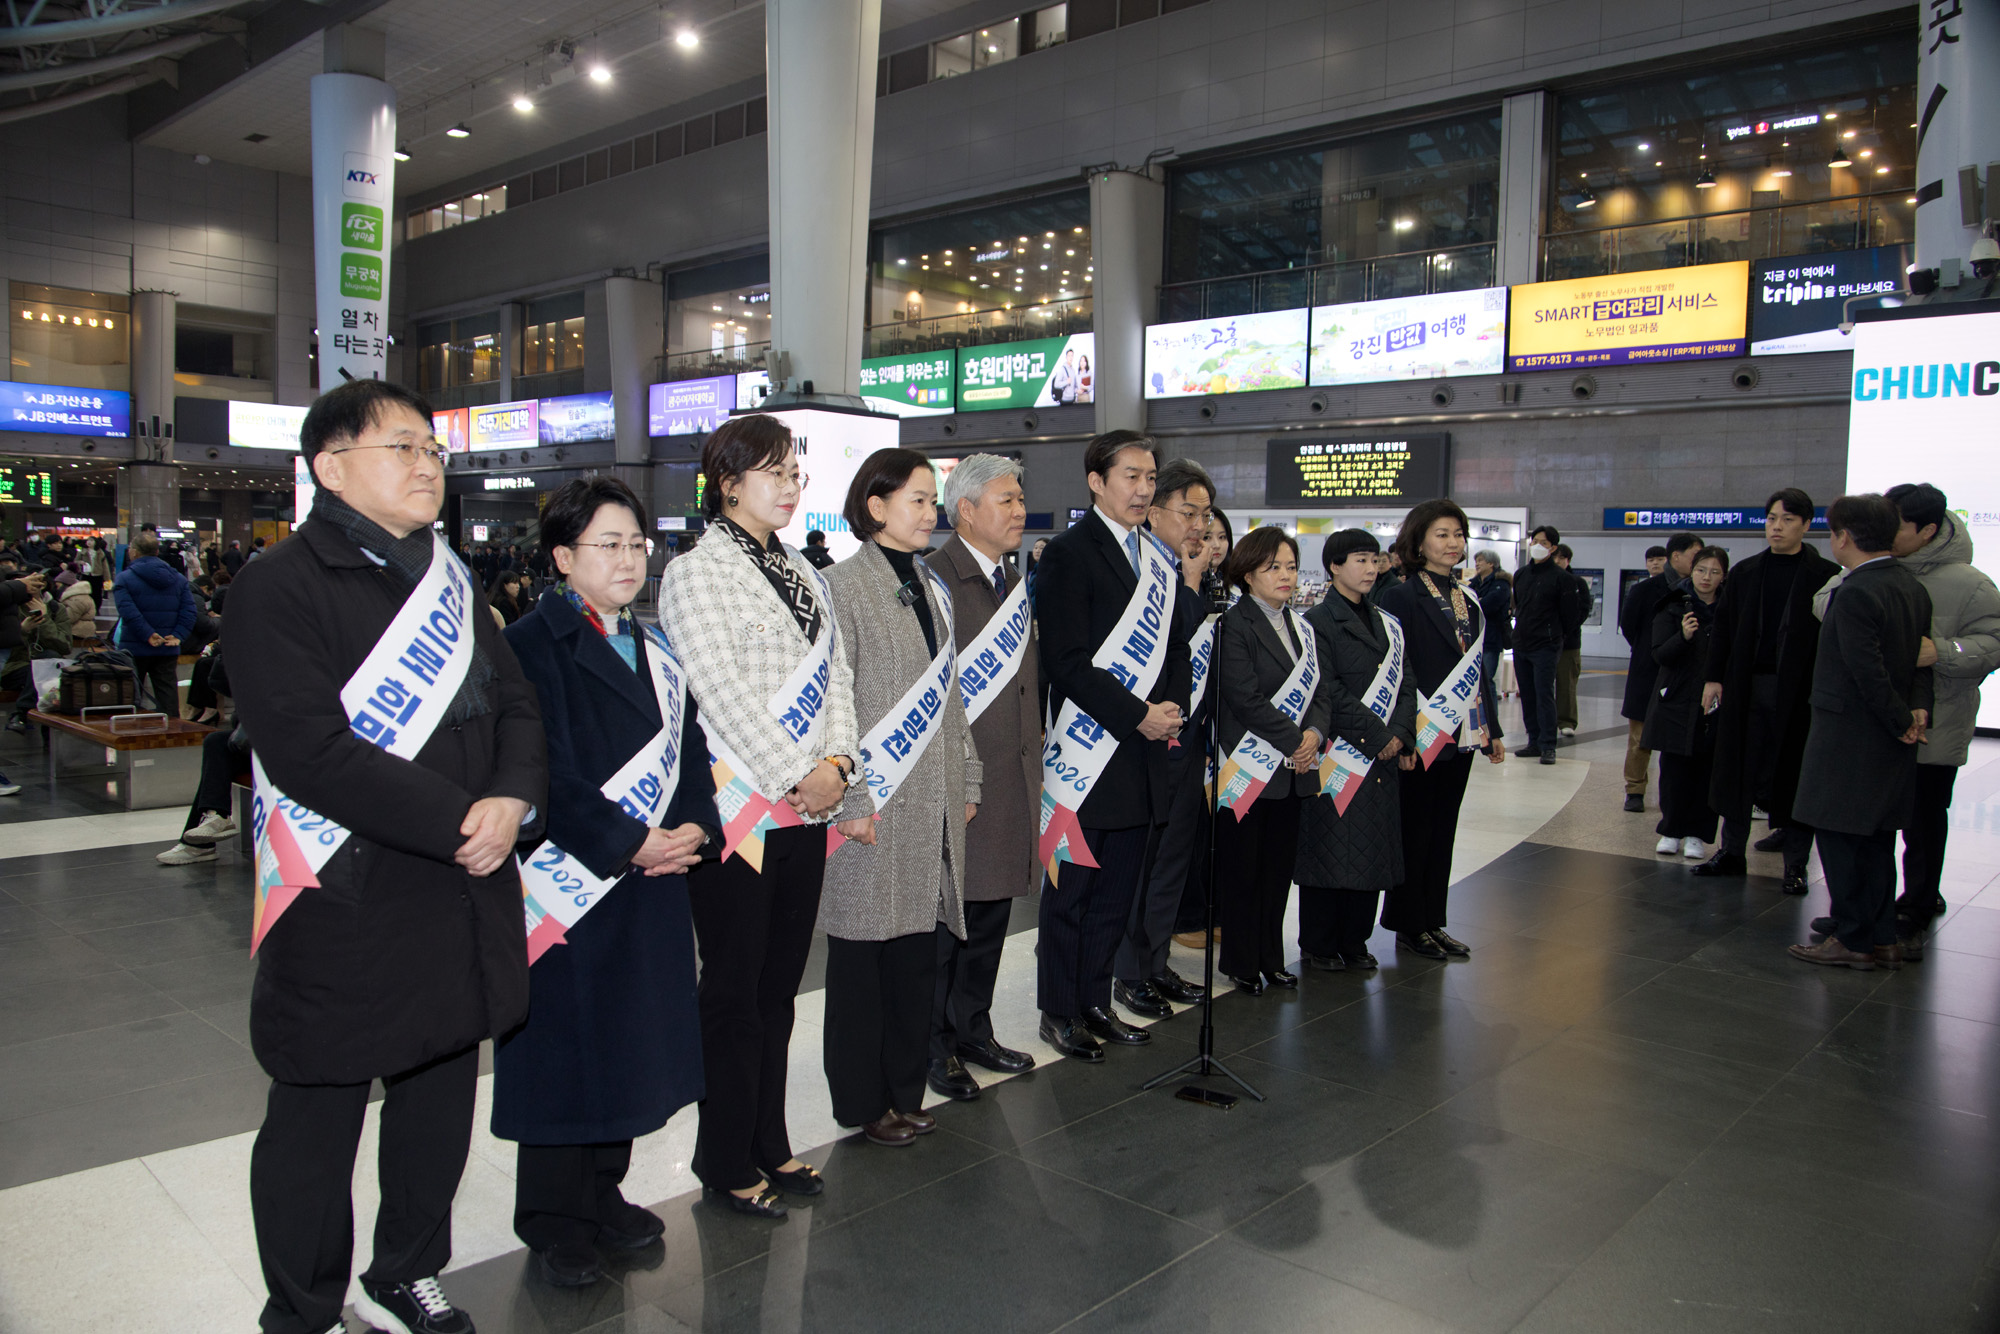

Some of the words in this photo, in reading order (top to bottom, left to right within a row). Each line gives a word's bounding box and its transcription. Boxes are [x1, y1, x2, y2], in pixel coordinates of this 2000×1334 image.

[347, 169, 380, 185] KTX
[350, 231, 376, 244] 새마을
[345, 265, 380, 283] 무궁화
[1764, 268, 1785, 282] 지금
[1788, 268, 1799, 280] 이
[1801, 264, 1835, 279] 역에서
[344, 281, 380, 294] Mugunghwa
[1574, 291, 1593, 300] 노동부
[1610, 287, 1637, 296] 노무사가
[1838, 280, 1895, 297] 만나보세요
[1534, 305, 1591, 323] SMART
[1595, 296, 1662, 320] 급여관리
[1667, 292, 1718, 312] 서비스
[341, 308, 379, 331] 열차
[1585, 324, 1625, 338] 노무법인
[334, 333, 368, 355] 타는
[373, 337, 384, 358] 곳
[1204, 321, 1238, 350] 고흥
[1350, 334, 1382, 360] 강진
[1389, 322, 1422, 350] 반값
[1431, 313, 1466, 338] 여행
[1526, 354, 1572, 366] 1577-9173
[1628, 348, 1668, 359] 급여아웃소싱
[1673, 345, 1702, 356] ERP개발
[1707, 343, 1736, 354] 산재보상
[878, 364, 904, 383] 인재를
[905, 362, 933, 381] 키우는
[963, 352, 1046, 385] 호원대학교
[38, 393, 104, 409] JB자산운용
[28, 410, 114, 427] JB인베스트먼트
[477, 409, 530, 434] 전주기전대학
[806, 512, 850, 532] CHUN
[1653, 511, 1743, 525] 전철승차권자동발매기
[1122, 556, 1168, 667] 혁신으로
[1429, 694, 1459, 725] 2026
[881, 686, 941, 763] 희망찬
[1416, 725, 1440, 749] 福
[1239, 738, 1274, 771] 2026
[1046, 741, 1092, 793] 2026
[1226, 771, 1251, 798] 福
[1326, 769, 1349, 793] 福
[532, 846, 595, 908] 2026
